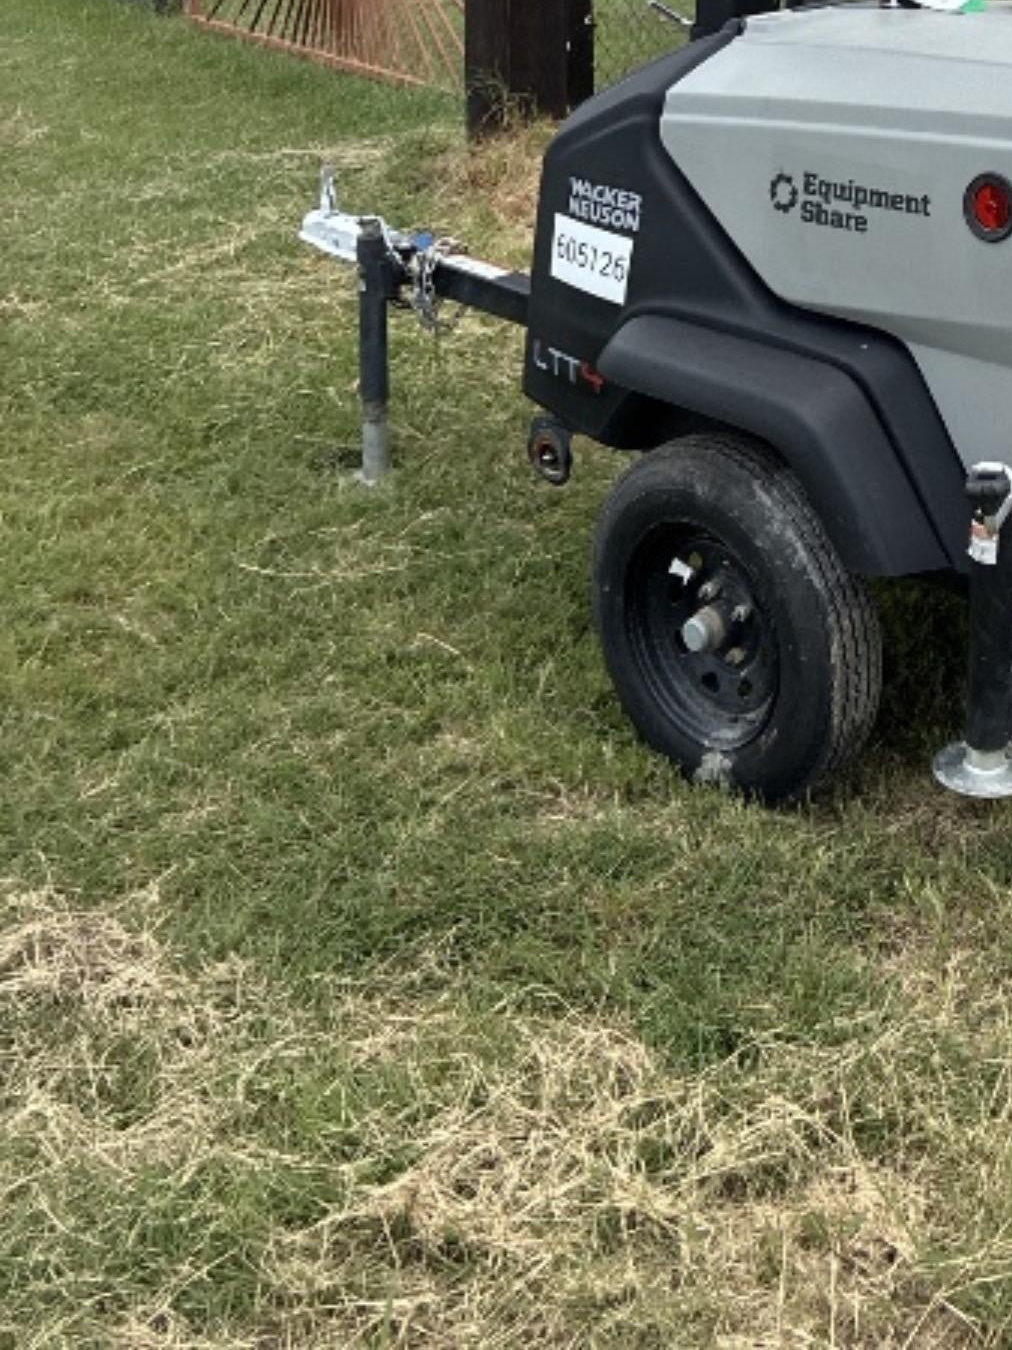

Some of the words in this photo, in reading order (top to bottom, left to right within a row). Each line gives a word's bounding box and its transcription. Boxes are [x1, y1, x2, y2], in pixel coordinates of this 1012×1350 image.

[569, 176, 642, 215] WACKER
[803, 170, 931, 217] Equipment
[568, 196, 640, 231] NEUSON
[801, 200, 868, 233] Share
